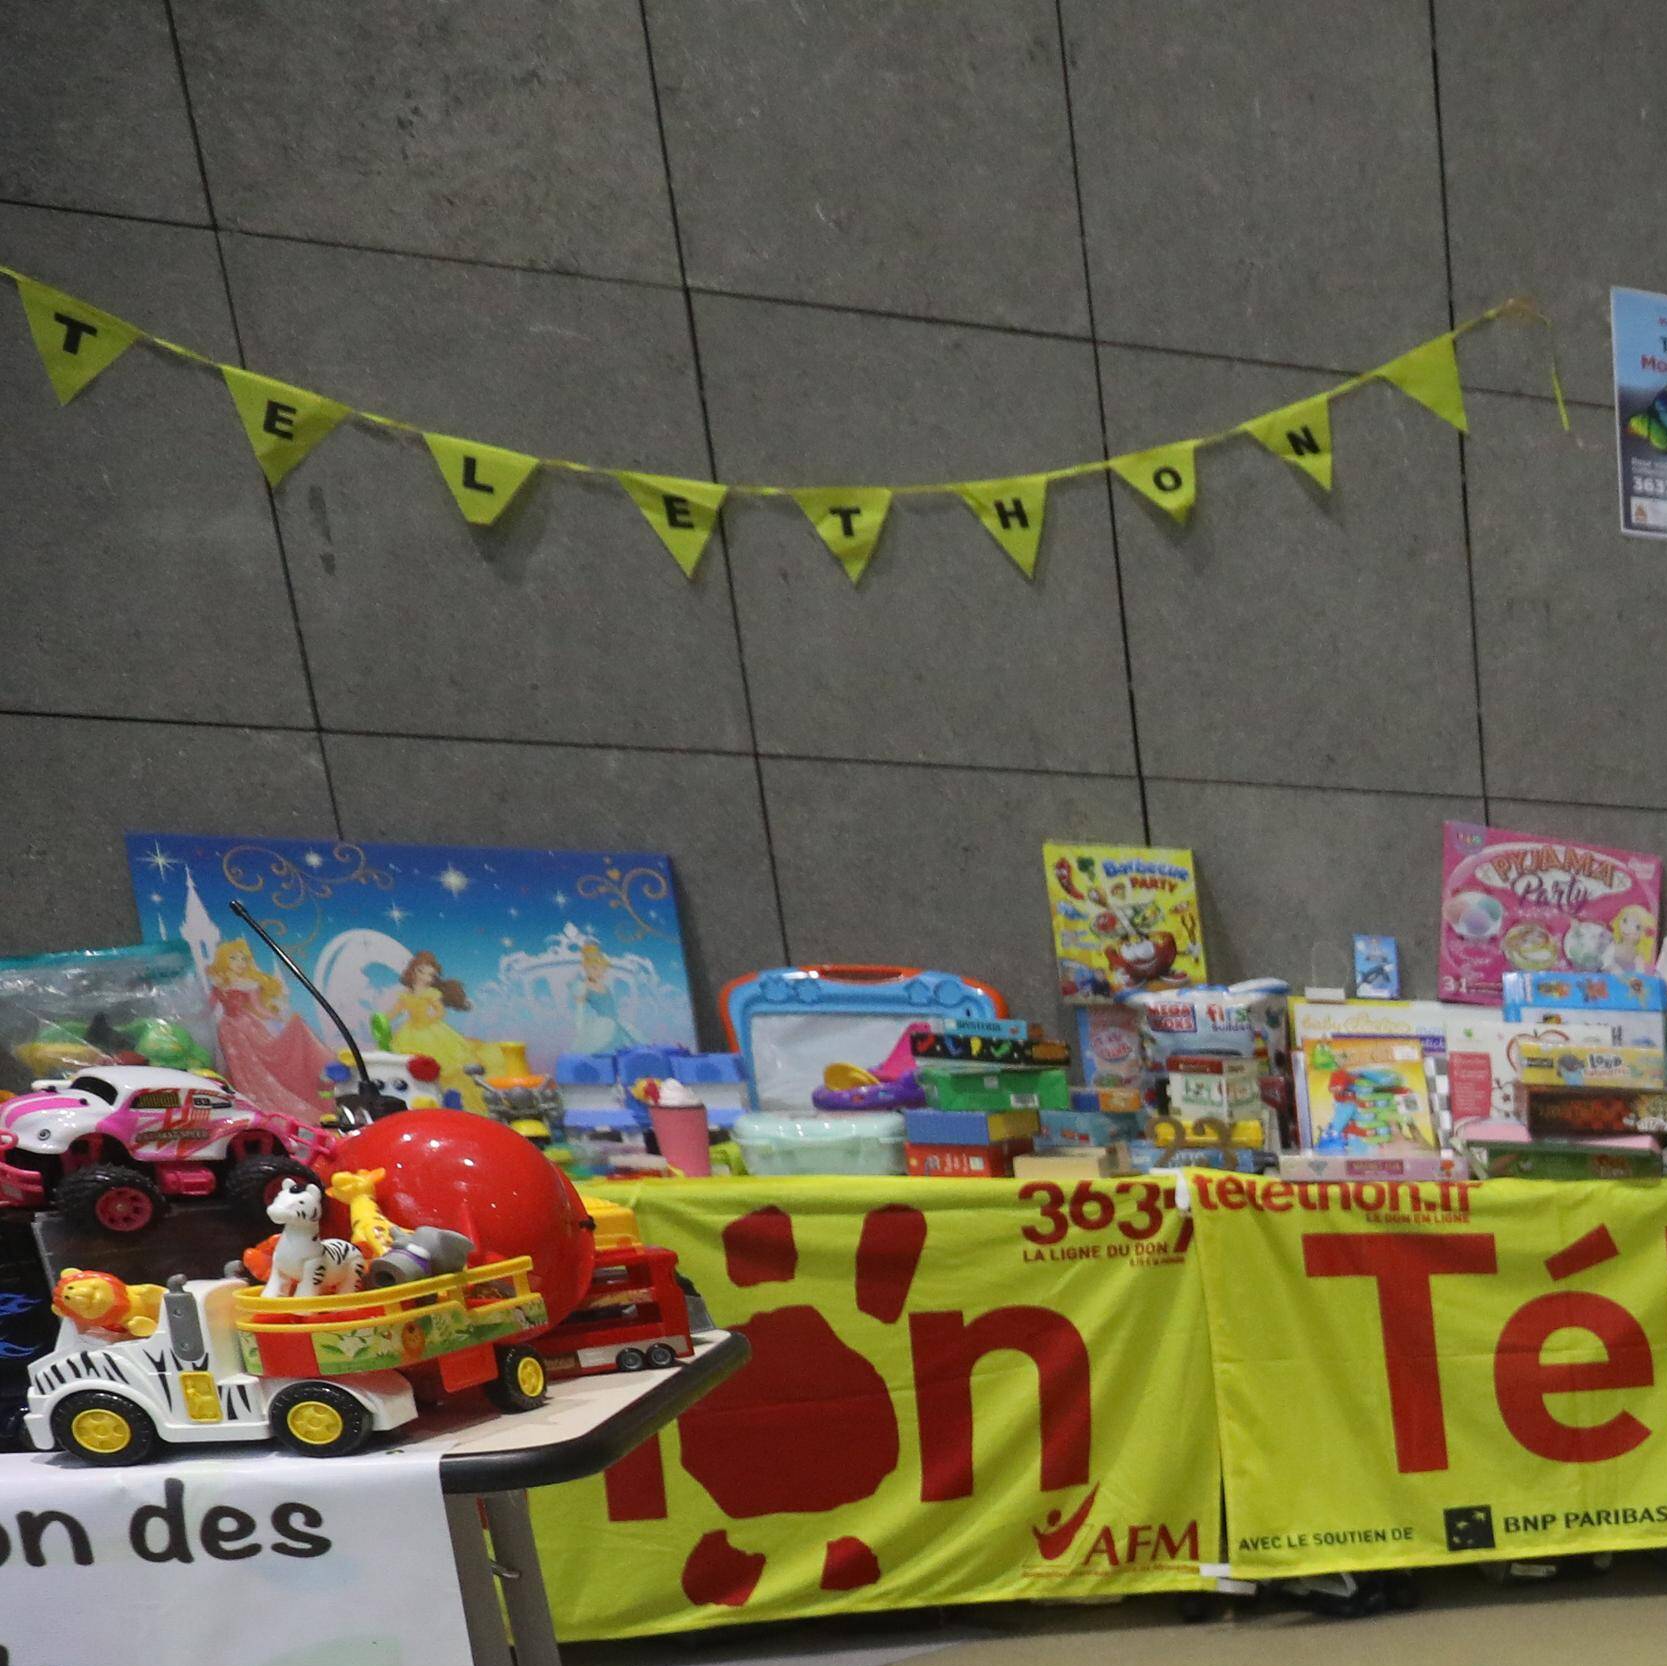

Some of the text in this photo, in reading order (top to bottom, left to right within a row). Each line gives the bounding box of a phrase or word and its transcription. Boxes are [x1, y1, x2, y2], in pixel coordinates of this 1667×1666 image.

[1102, 860, 1189, 881] Barbecue
[1493, 846, 1615, 887] PYJAMA
[1129, 877, 1178, 893] PARTY
[1512, 874, 1589, 914] Party
[1147, 1004, 1192, 1016] MEGA
[1384, 1213, 1411, 1223] DON
[1413, 1213, 1432, 1223] EN
[1434, 1213, 1470, 1224] LIGNE
[1023, 1241, 1168, 1263] LA LIGNE DU DON
[130, 1478, 332, 1564] des
[1504, 1513, 1557, 1534] BNP
[1084, 1520, 1199, 1566] AFM
[1239, 1527, 1413, 1551] AVEC LE SOUTIEN DE
